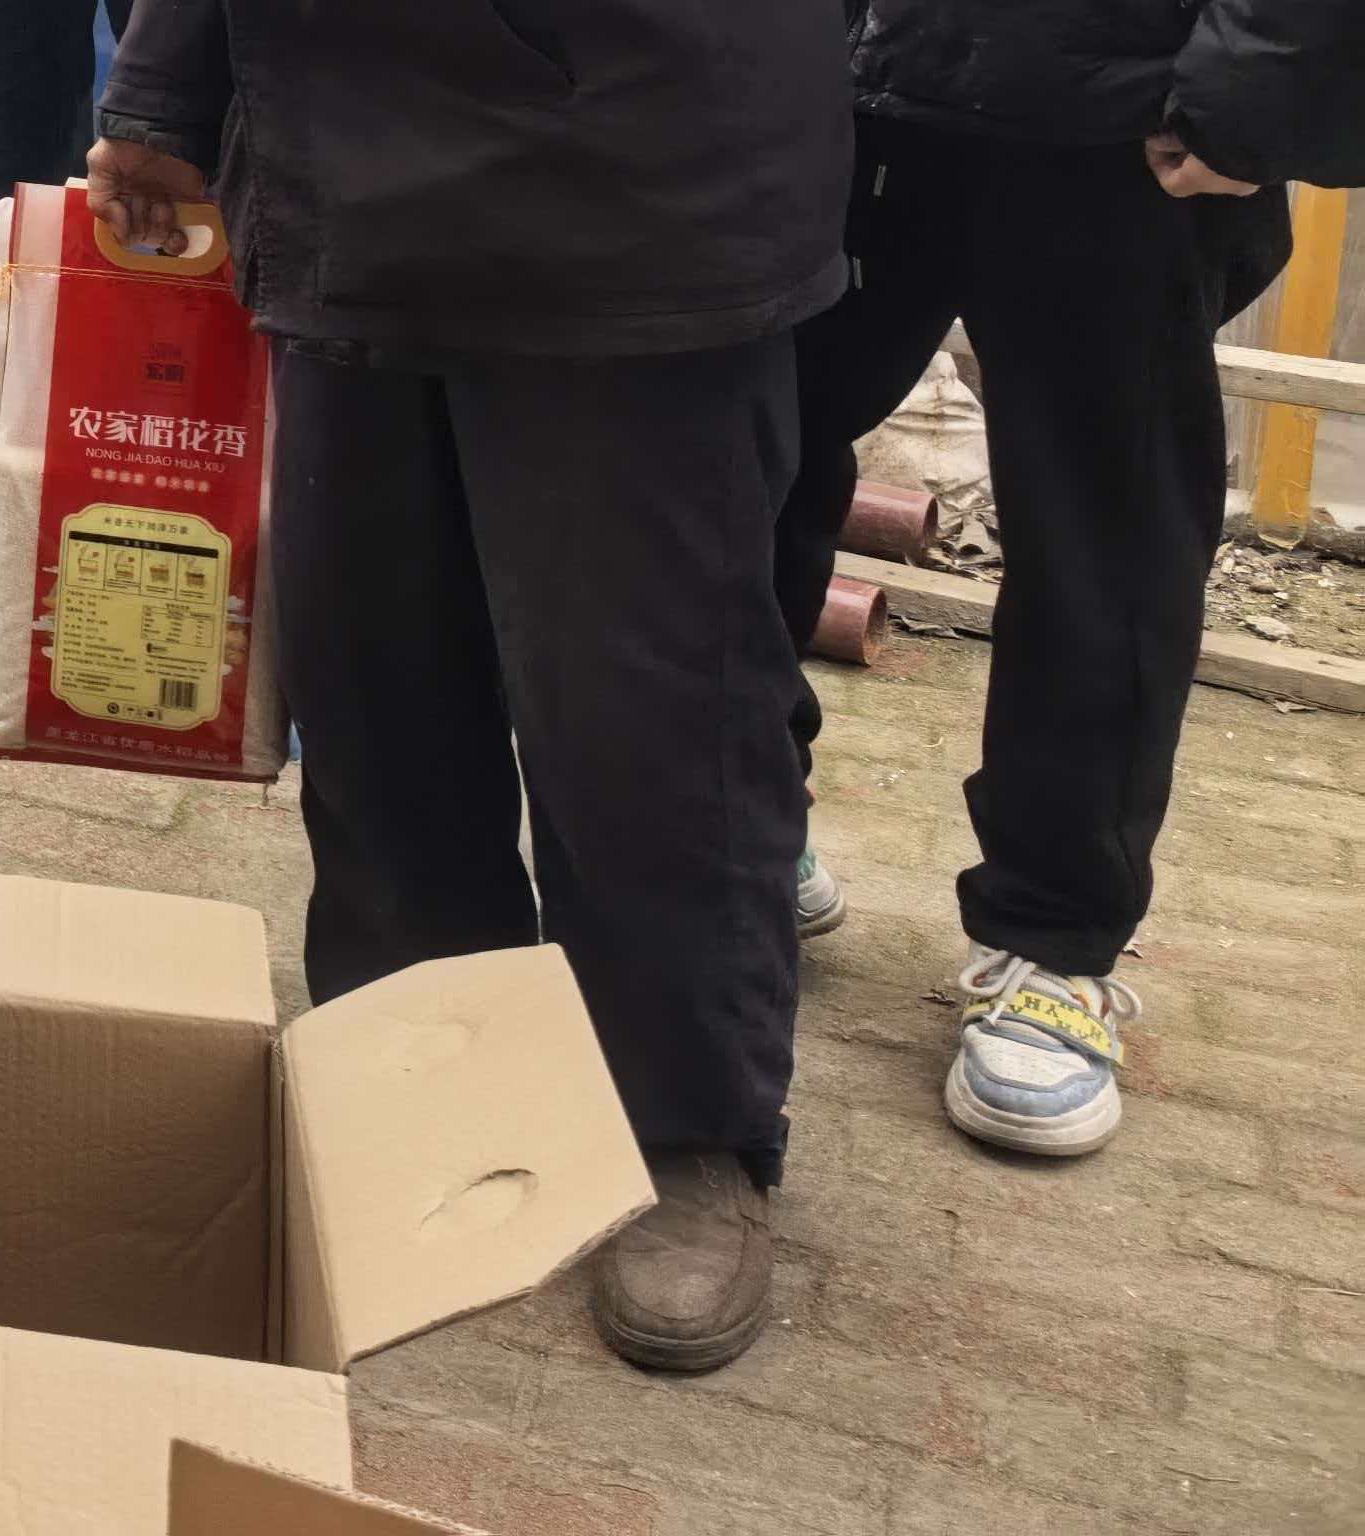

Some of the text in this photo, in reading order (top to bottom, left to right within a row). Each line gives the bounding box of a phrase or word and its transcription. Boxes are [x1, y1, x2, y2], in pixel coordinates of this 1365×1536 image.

[69, 406, 248, 458] 农家稻花香
[85, 447, 122, 461] NONG
[124, 452, 143, 464] JIA
[145, 454, 172, 465] DAO
[175, 458, 200, 470] HUA
